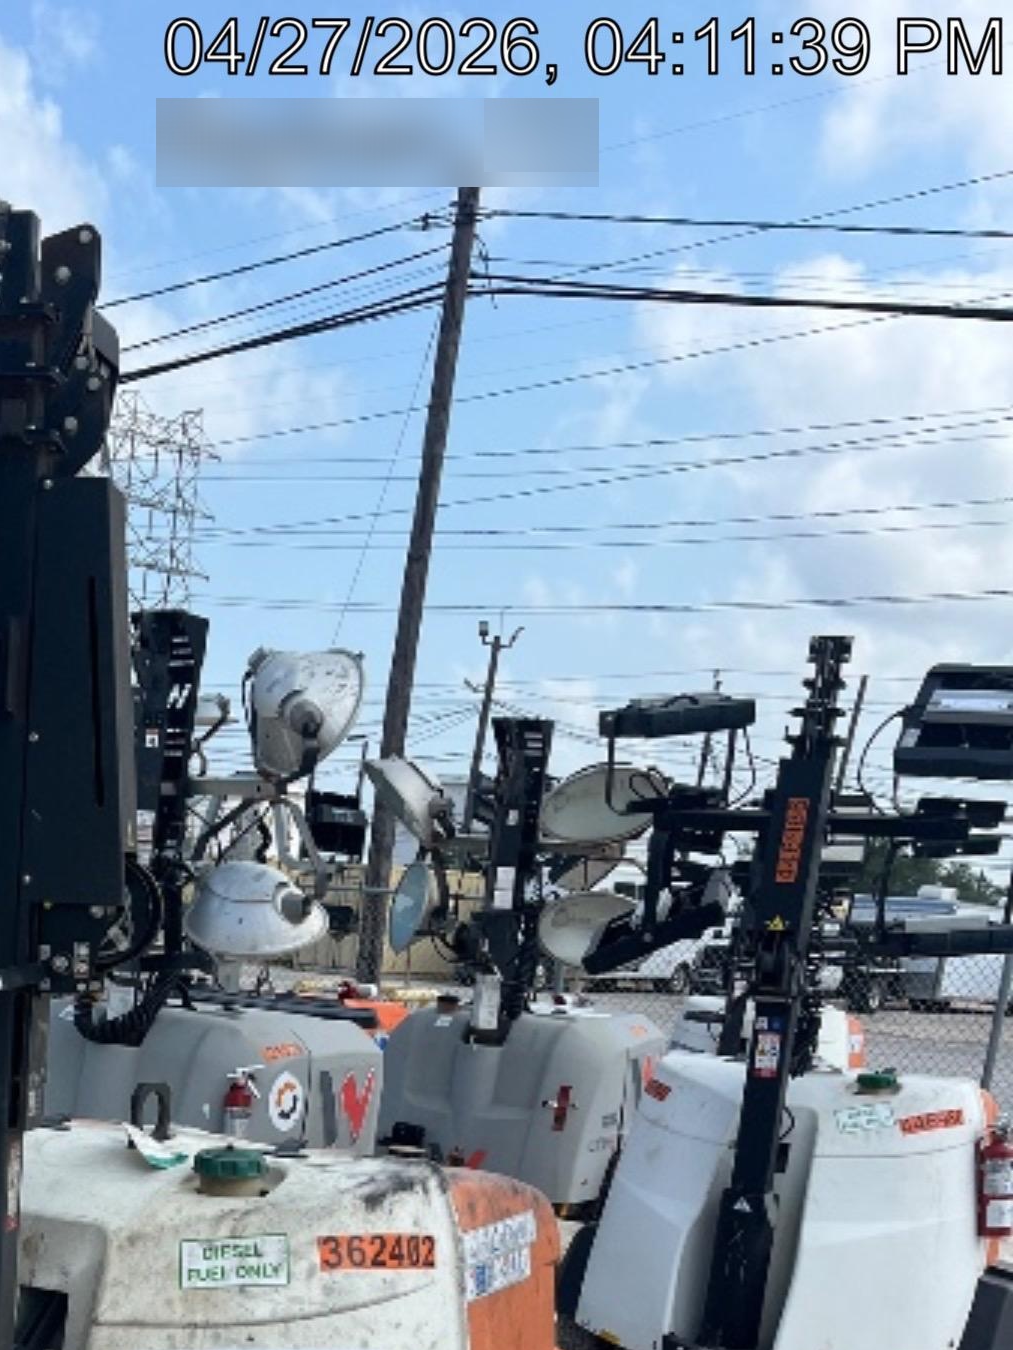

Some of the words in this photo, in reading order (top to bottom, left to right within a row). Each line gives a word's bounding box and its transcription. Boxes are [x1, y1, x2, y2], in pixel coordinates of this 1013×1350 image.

[202, 1243, 263, 1261] DIESEL
[321, 1235, 436, 1270] 362402
[187, 1267, 225, 1282] FUEL
[235, 1262, 281, 1280] ONLY
